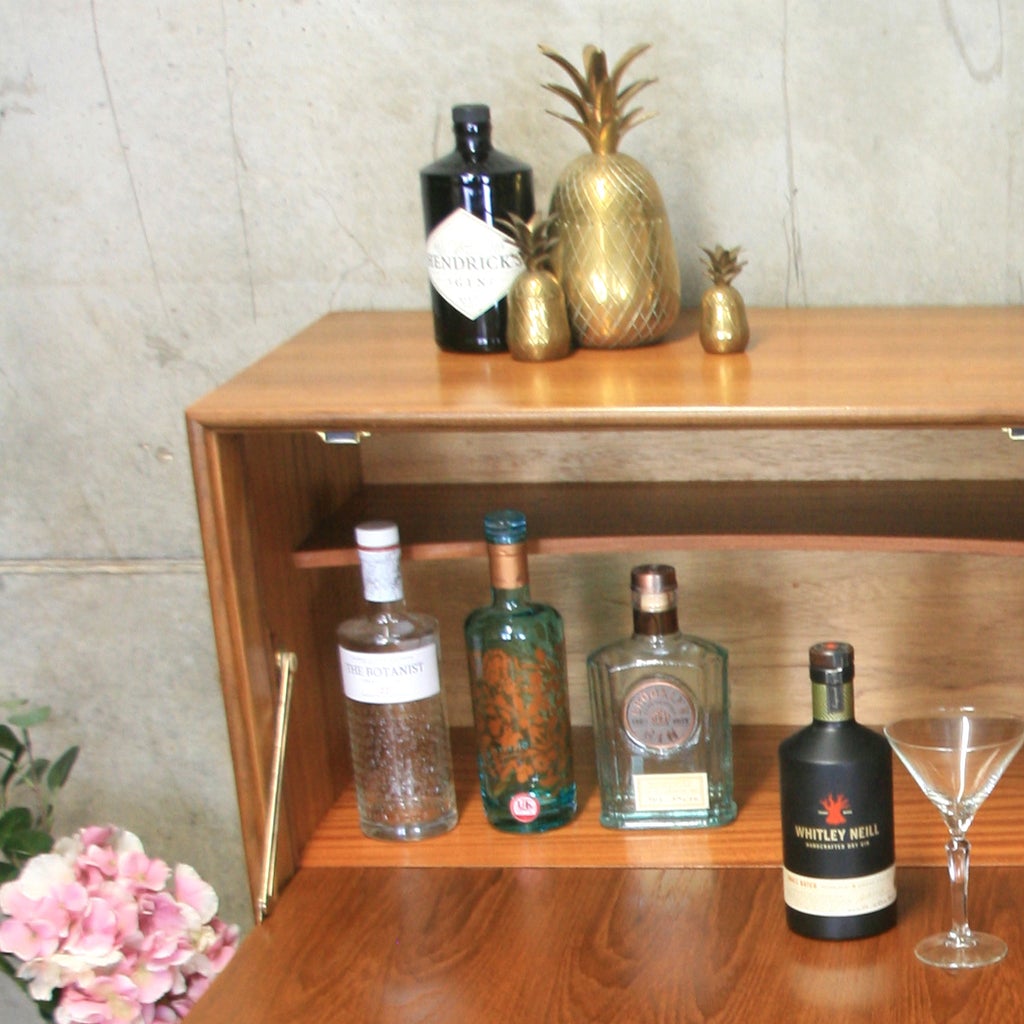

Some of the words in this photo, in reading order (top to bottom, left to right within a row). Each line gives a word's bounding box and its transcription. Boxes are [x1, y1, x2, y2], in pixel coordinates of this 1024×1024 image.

[346, 663, 364, 677] THE
[366, 662, 424, 678] BOTANIST
[795, 825, 846, 842] WHITLEY
[849, 823, 880, 840] NEILL
